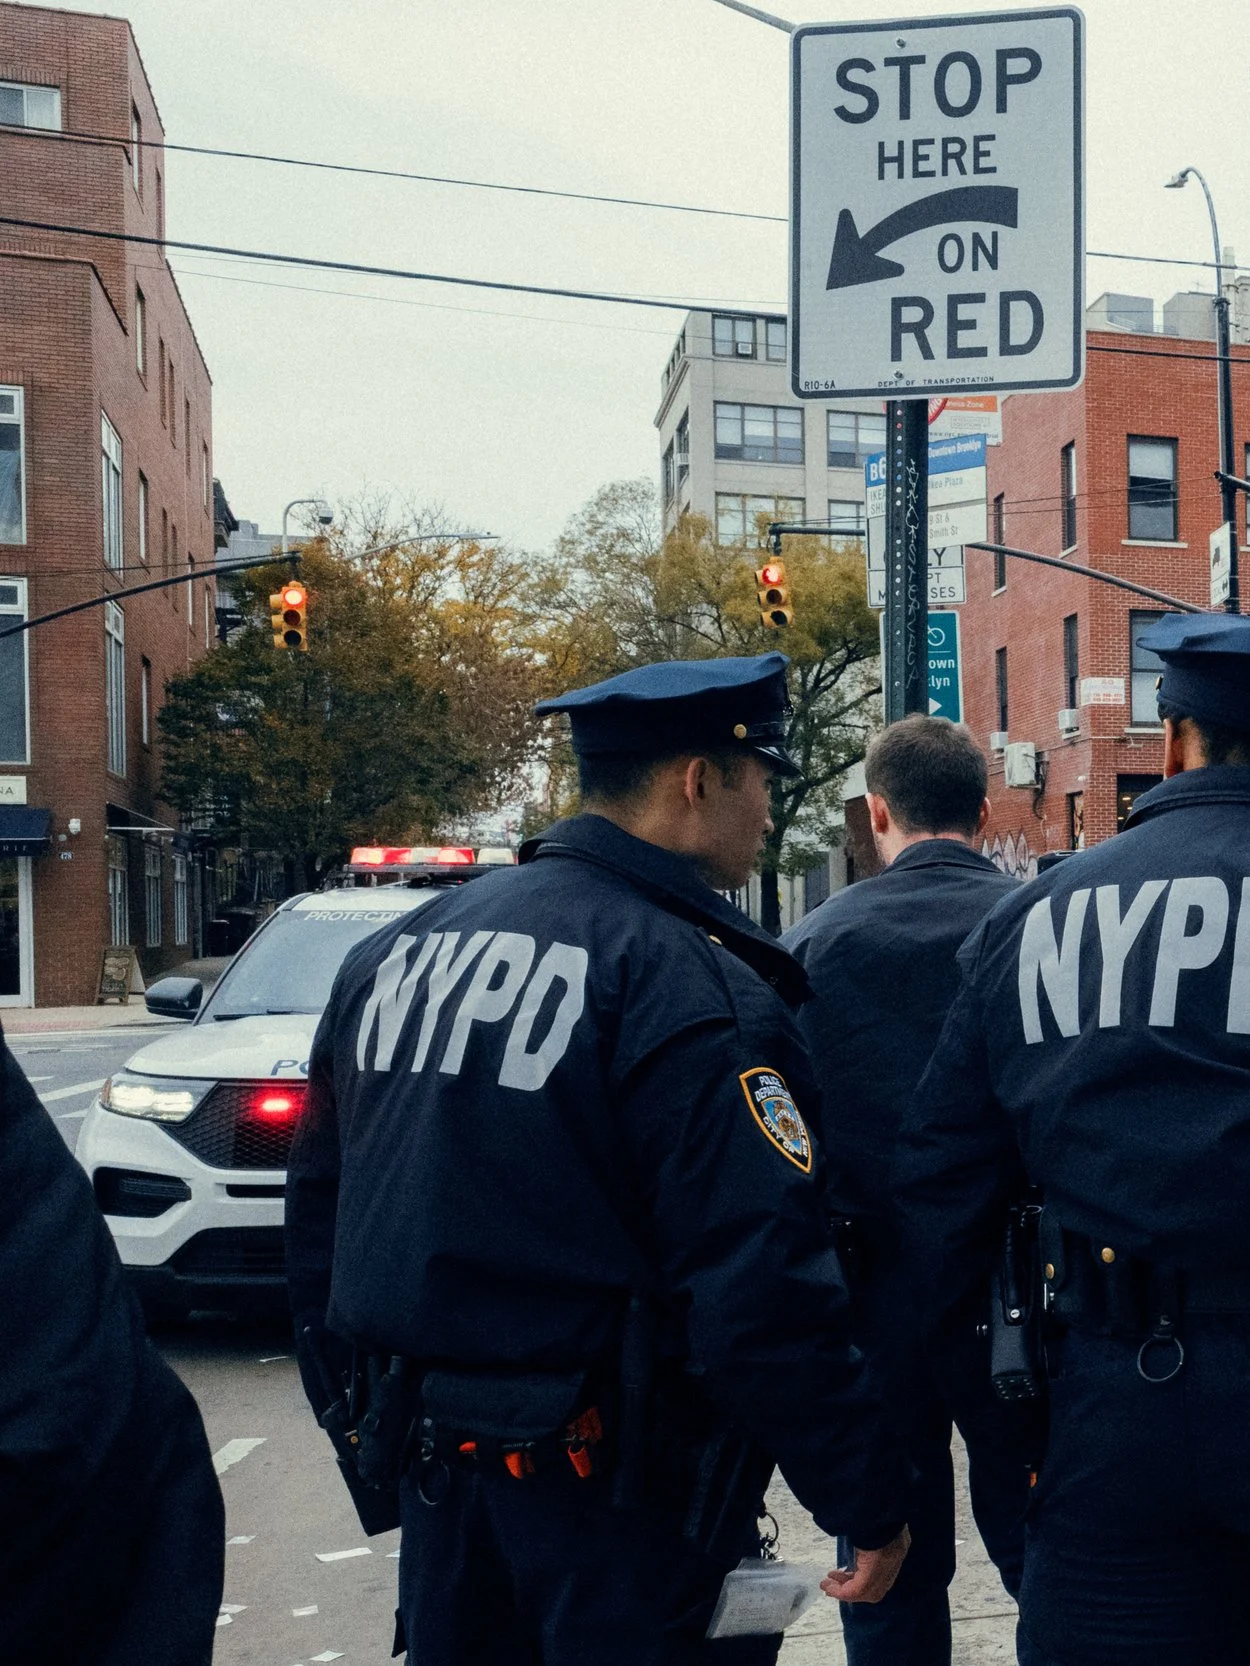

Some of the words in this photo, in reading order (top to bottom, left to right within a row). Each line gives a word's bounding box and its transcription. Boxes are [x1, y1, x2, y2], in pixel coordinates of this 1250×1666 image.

[833, 47, 1043, 124] STOP
[878, 134, 997, 180] HERE
[937, 231, 999, 274] ON
[890, 290, 1044, 362] RED
[923, 376, 994, 385] TRANSPORTATION
[356, 930, 589, 1092] NYPD
[763, 1116, 782, 1139] CITY
